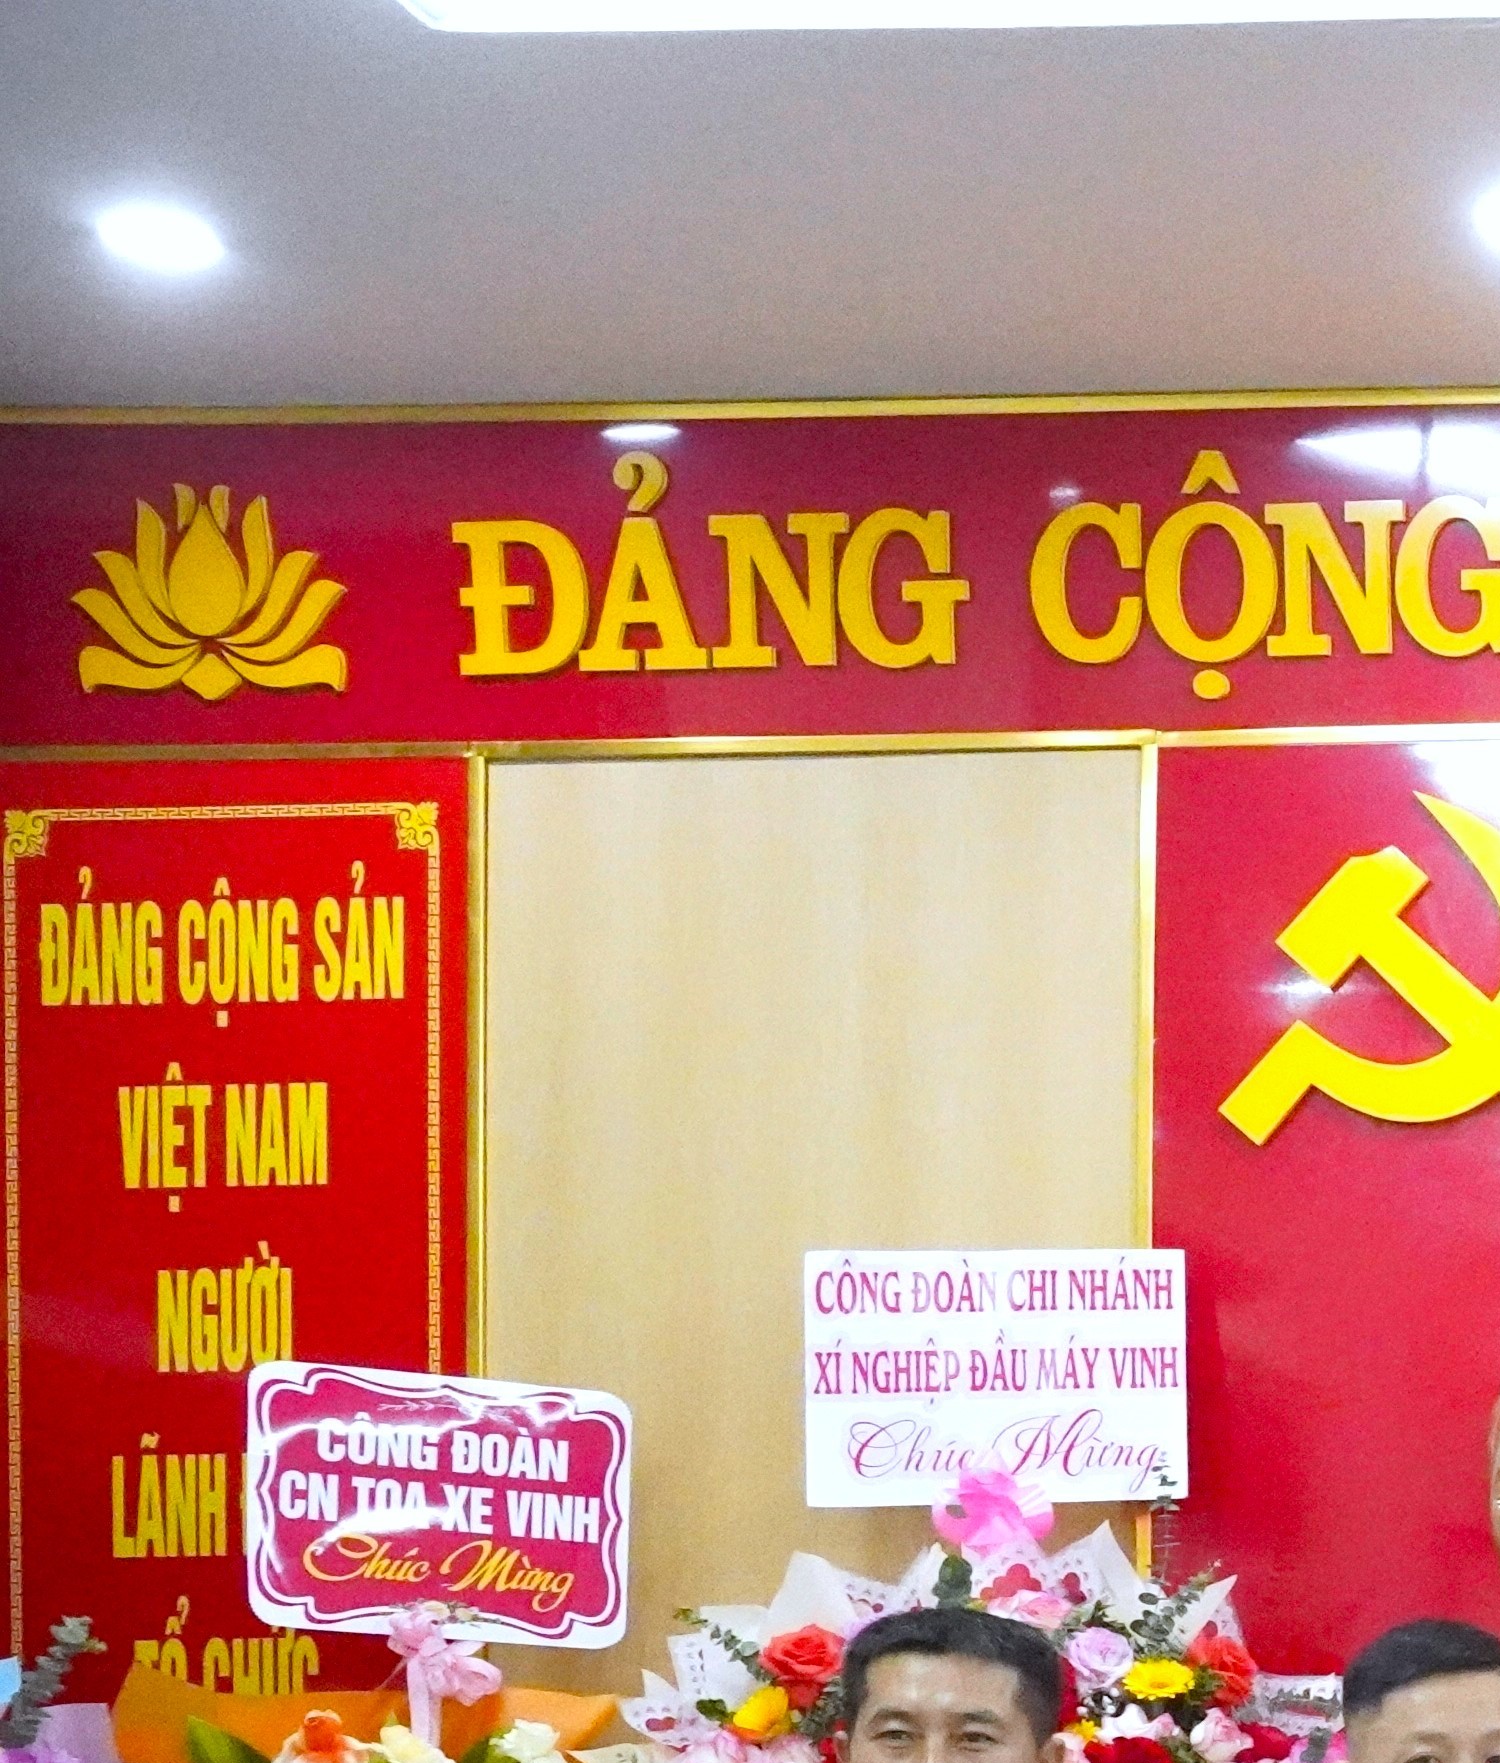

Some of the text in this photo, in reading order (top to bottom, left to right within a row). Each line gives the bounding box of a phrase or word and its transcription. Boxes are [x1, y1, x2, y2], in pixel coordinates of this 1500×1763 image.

[450, 452, 970, 677] ĐẢNG
[39, 860, 405, 1027] ĐẢNG CỘNG SẢN
[118, 1063, 328, 1212] VIỆT NAM
[156, 1241, 292, 1372] NGƯỜI
[815, 1257, 1174, 1314] CÔNG ĐOÀN CHI NHÁNH
[813, 1330, 1179, 1404] XÍ NGHIỆP ĐẦU MÁY VINH
[317, 1412, 569, 1482] CÔNG ĐOÀN
[848, 1409, 1160, 1493] Chúc Mừng
[112, 1433, 226, 1558] LÃNH
[278, 1471, 339, 1522] CN
[442, 1483, 493, 1534] XE
[507, 1490, 600, 1543] VINH
[303, 1534, 574, 1613] Chúc Mừng
